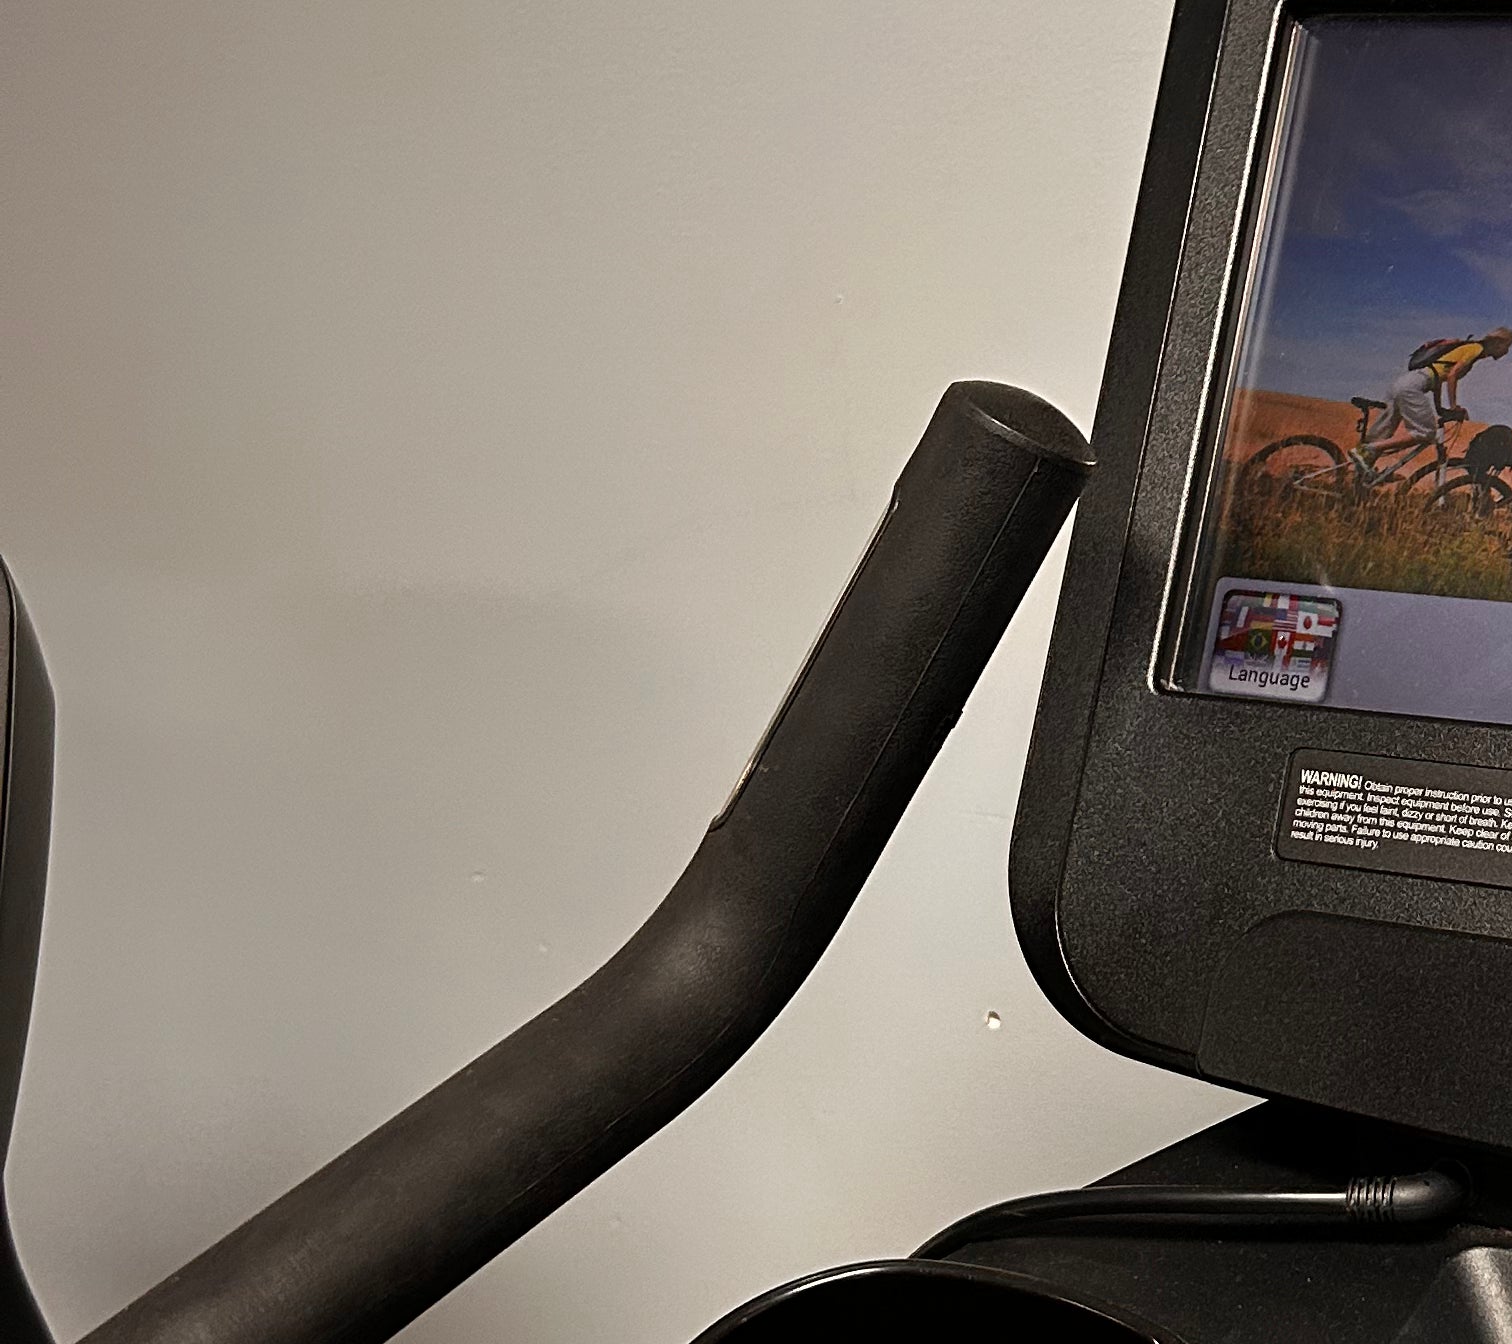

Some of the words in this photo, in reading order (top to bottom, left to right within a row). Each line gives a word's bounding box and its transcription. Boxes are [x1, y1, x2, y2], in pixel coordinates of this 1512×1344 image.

[1229, 664, 1310, 691] Language
[1299, 785, 1315, 795] this
[1367, 792, 1400, 805] Inspect
[1401, 798, 1449, 811] equipment
[1451, 802, 1480, 814] before
[1301, 769, 1363, 790] WARNING!
[1364, 781, 1393, 793] Obtain
[1393, 786, 1424, 797] proper
[1424, 788, 1469, 802] instruction
[1471, 794, 1492, 804] prior
[1493, 796, 1503, 805] to
[1295, 807, 1330, 820] children
[1331, 814, 1356, 824] away
[1357, 814, 1377, 825] from
[1379, 817, 1395, 827] this
[1449, 825, 1475, 838] Keep
[1476, 829, 1499, 839] clear
[1500, 832, 1511, 841] of
[1297, 798, 1339, 811] exercising
[1339, 801, 1346, 811] if
[1346, 804, 1362, 812] you
[1363, 804, 1379, 814] feel
[1402, 808, 1424, 821] dizzy
[1425, 813, 1435, 821] or
[1435, 812, 1458, 823] short
[1459, 815, 1469, 825] of
[1290, 831, 1315, 840] result
[1315, 832, 1323, 841] in
[1324, 834, 1354, 845] serious
[1292, 820, 1324, 832] moving
[1351, 825, 1381, 837] Failure
[1381, 829, 1391, 838] to
[1393, 832, 1410, 840] use
[1410, 834, 1460, 847] appropriate
[1462, 840, 1495, 851] caution
